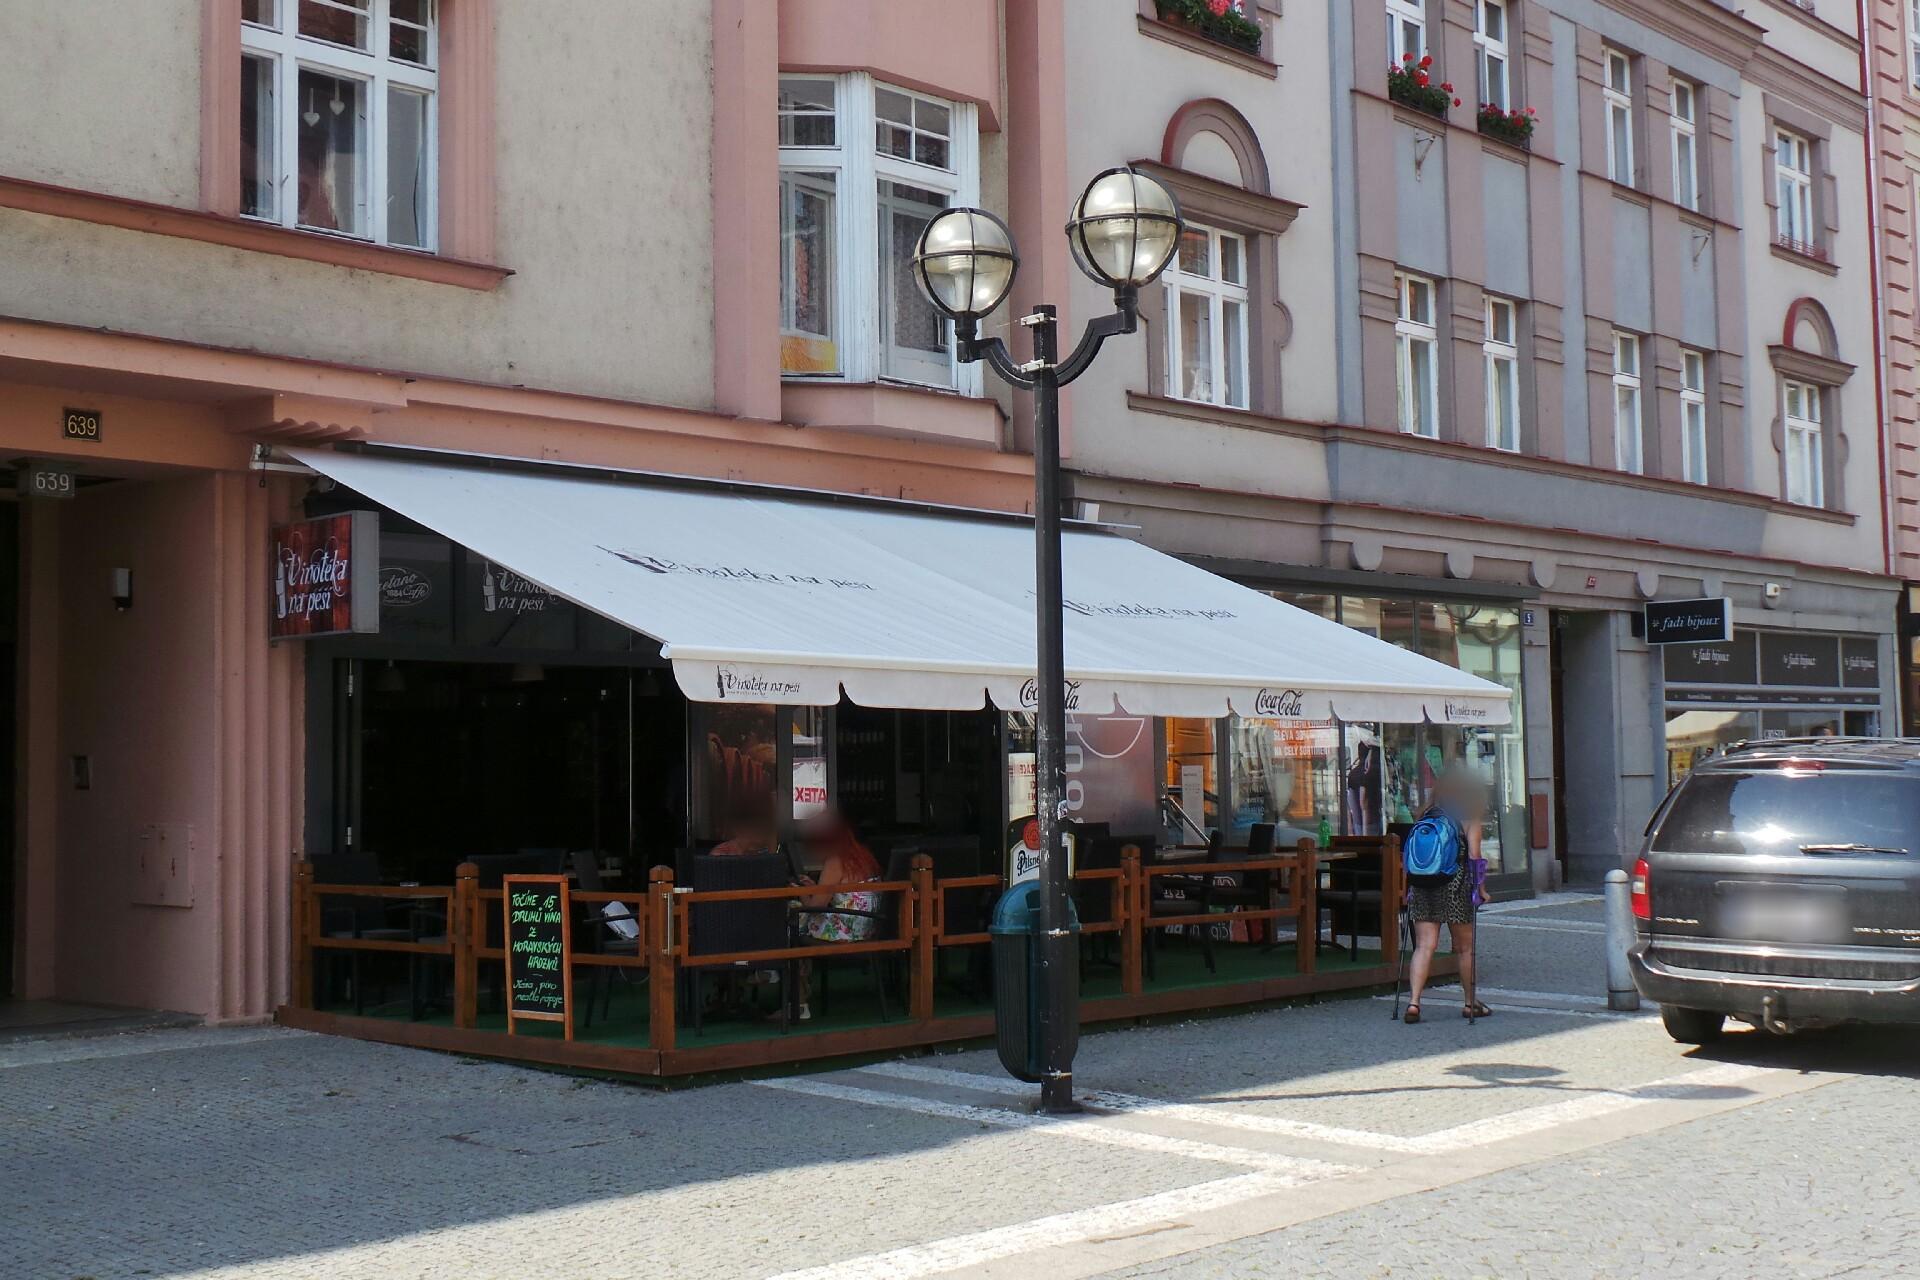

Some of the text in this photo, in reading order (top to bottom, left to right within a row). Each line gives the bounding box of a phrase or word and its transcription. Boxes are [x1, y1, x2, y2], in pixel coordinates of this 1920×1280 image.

[67, 415, 97, 436] 639
[35, 471, 70, 491] 639
[288, 592, 307, 614] na
[498, 596, 515, 610] na
[1659, 615, 1684, 632] fadi
[1255, 688, 1304, 716] Coca-Cola
[543, 895, 558, 908] 15
